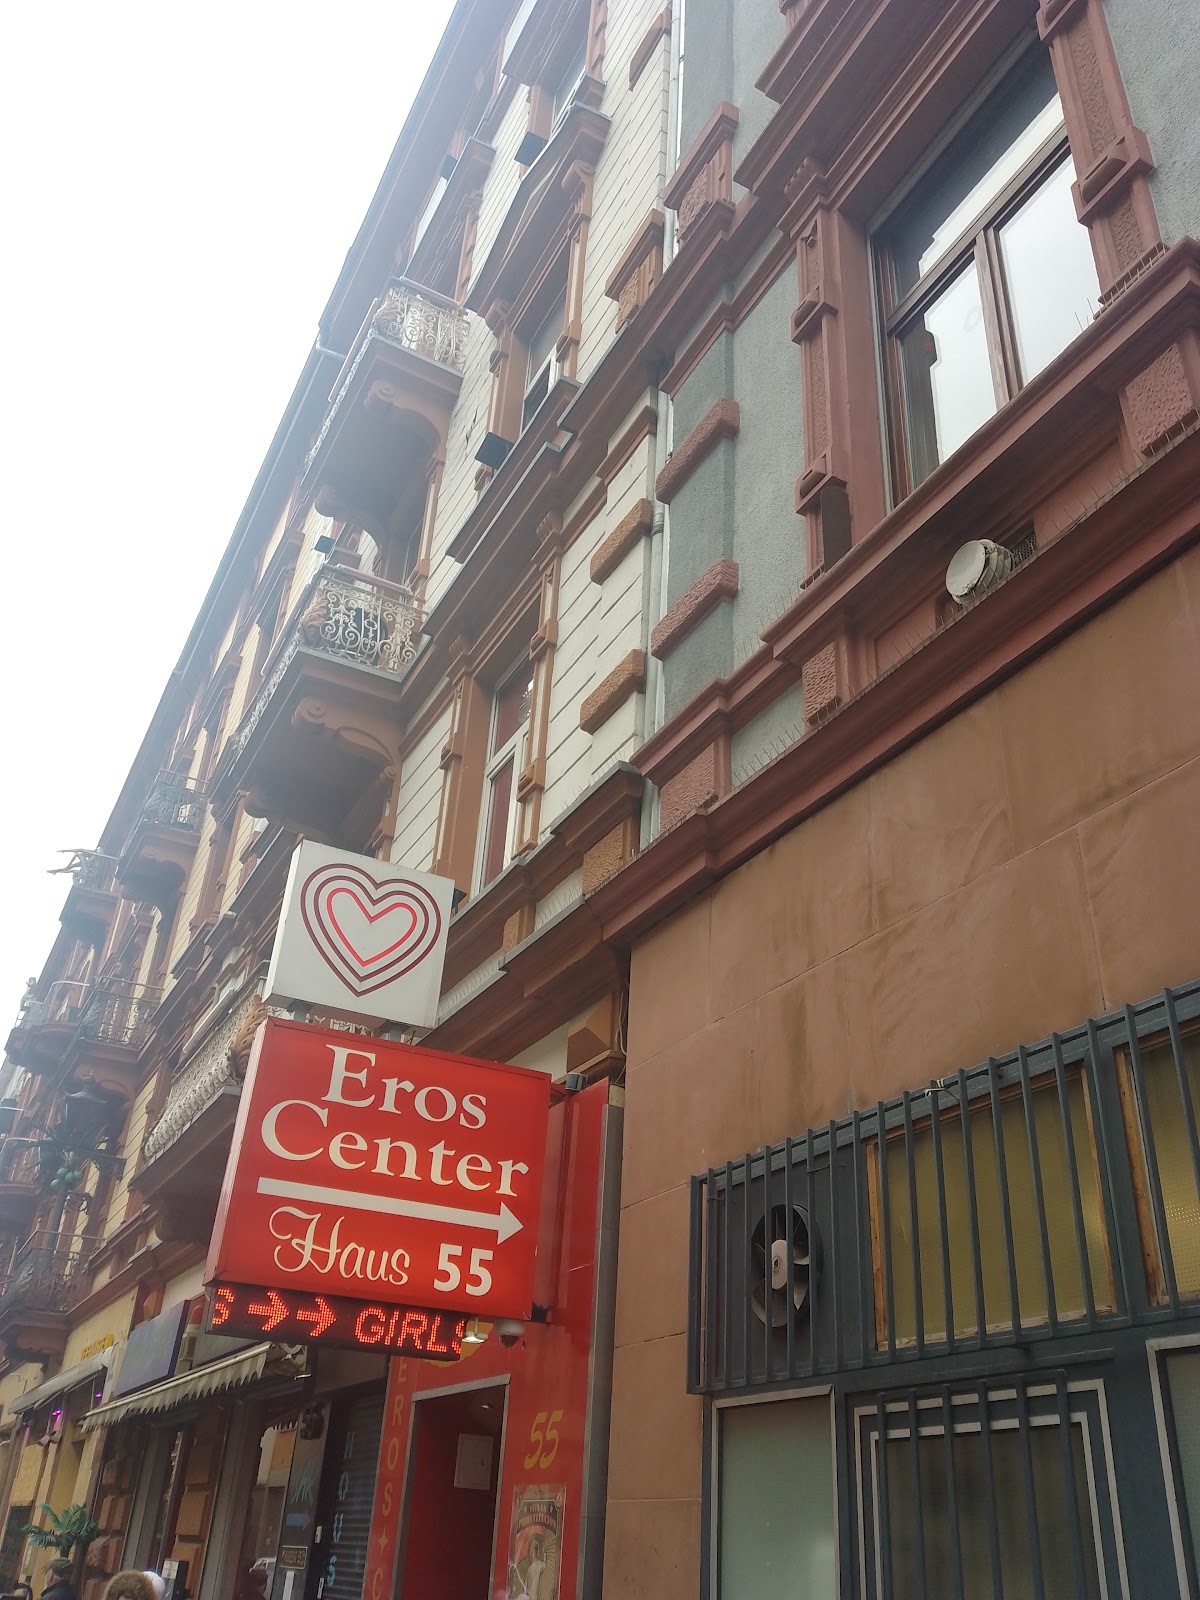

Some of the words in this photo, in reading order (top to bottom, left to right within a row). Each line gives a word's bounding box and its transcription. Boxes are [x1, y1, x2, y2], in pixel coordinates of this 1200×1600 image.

[321, 1044, 487, 1129] Eros
[261, 1100, 529, 1197] Center
[269, 1206, 410, 1285] Haus
[433, 1243, 494, 1296] 55
[524, 1410, 564, 1470] 55
